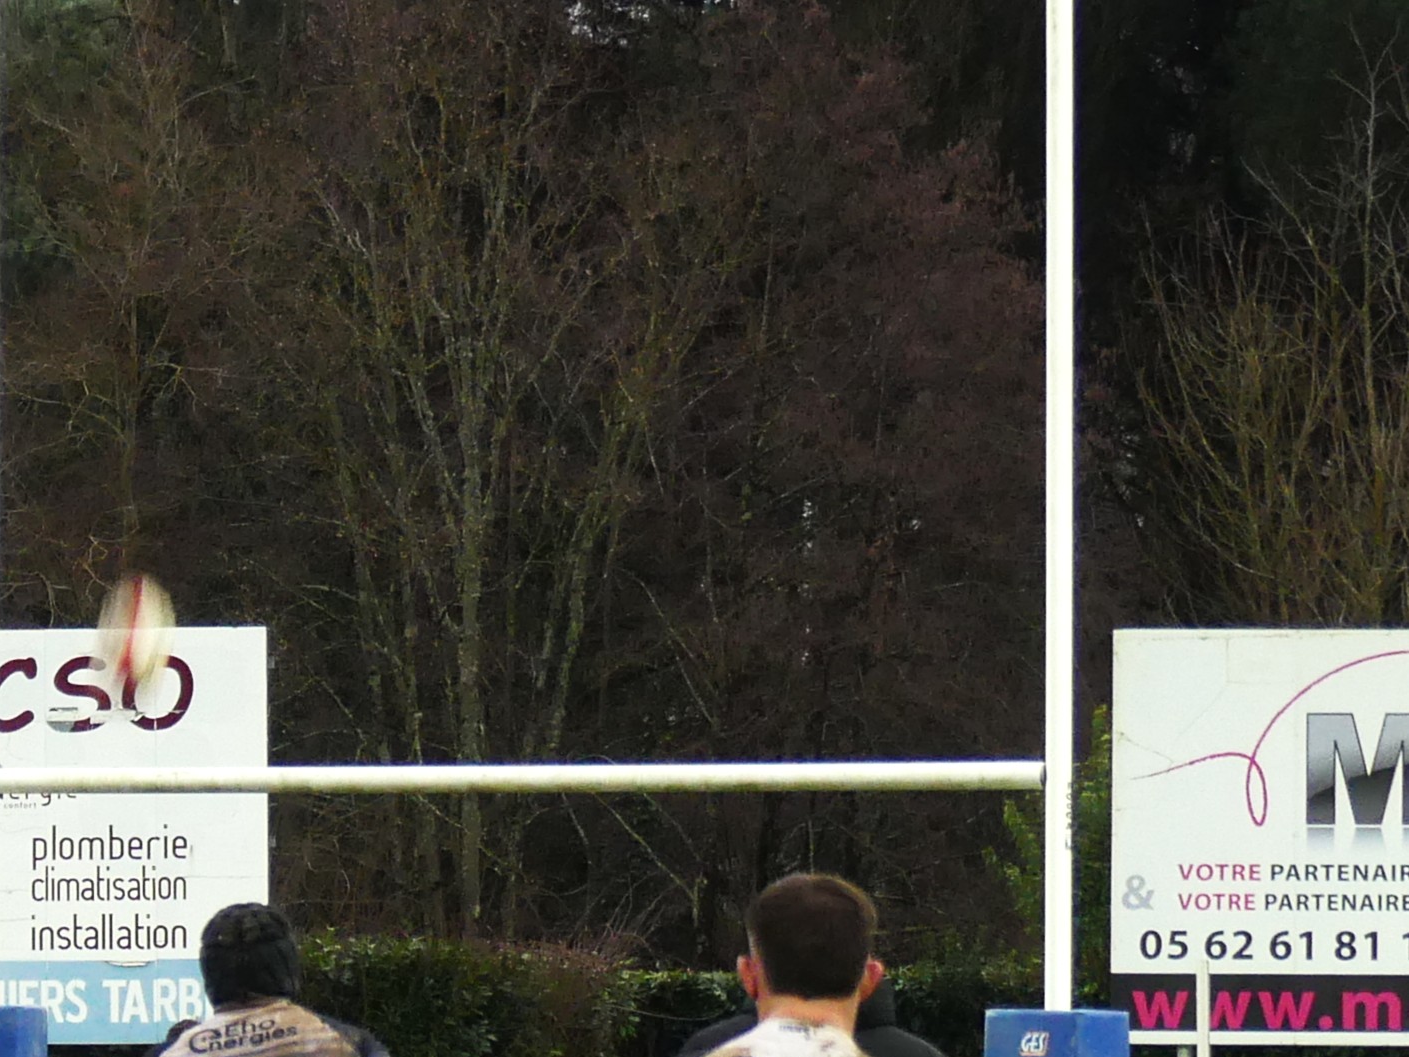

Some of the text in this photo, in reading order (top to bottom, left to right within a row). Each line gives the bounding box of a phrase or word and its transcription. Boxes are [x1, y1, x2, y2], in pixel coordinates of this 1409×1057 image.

[31, 825, 188, 871] plomberie
[31, 866, 188, 902] climatisation
[1178, 864, 1261, 881] VOTRE
[1178, 893, 1256, 910] VOTRE
[31, 913, 188, 951] installation
[1139, 930, 1189, 960] 05
[1205, 930, 1254, 960] 62
[1270, 931, 1313, 961] 61
[1334, 931, 1378, 961] 81
[102, 979, 214, 1024] TARB
